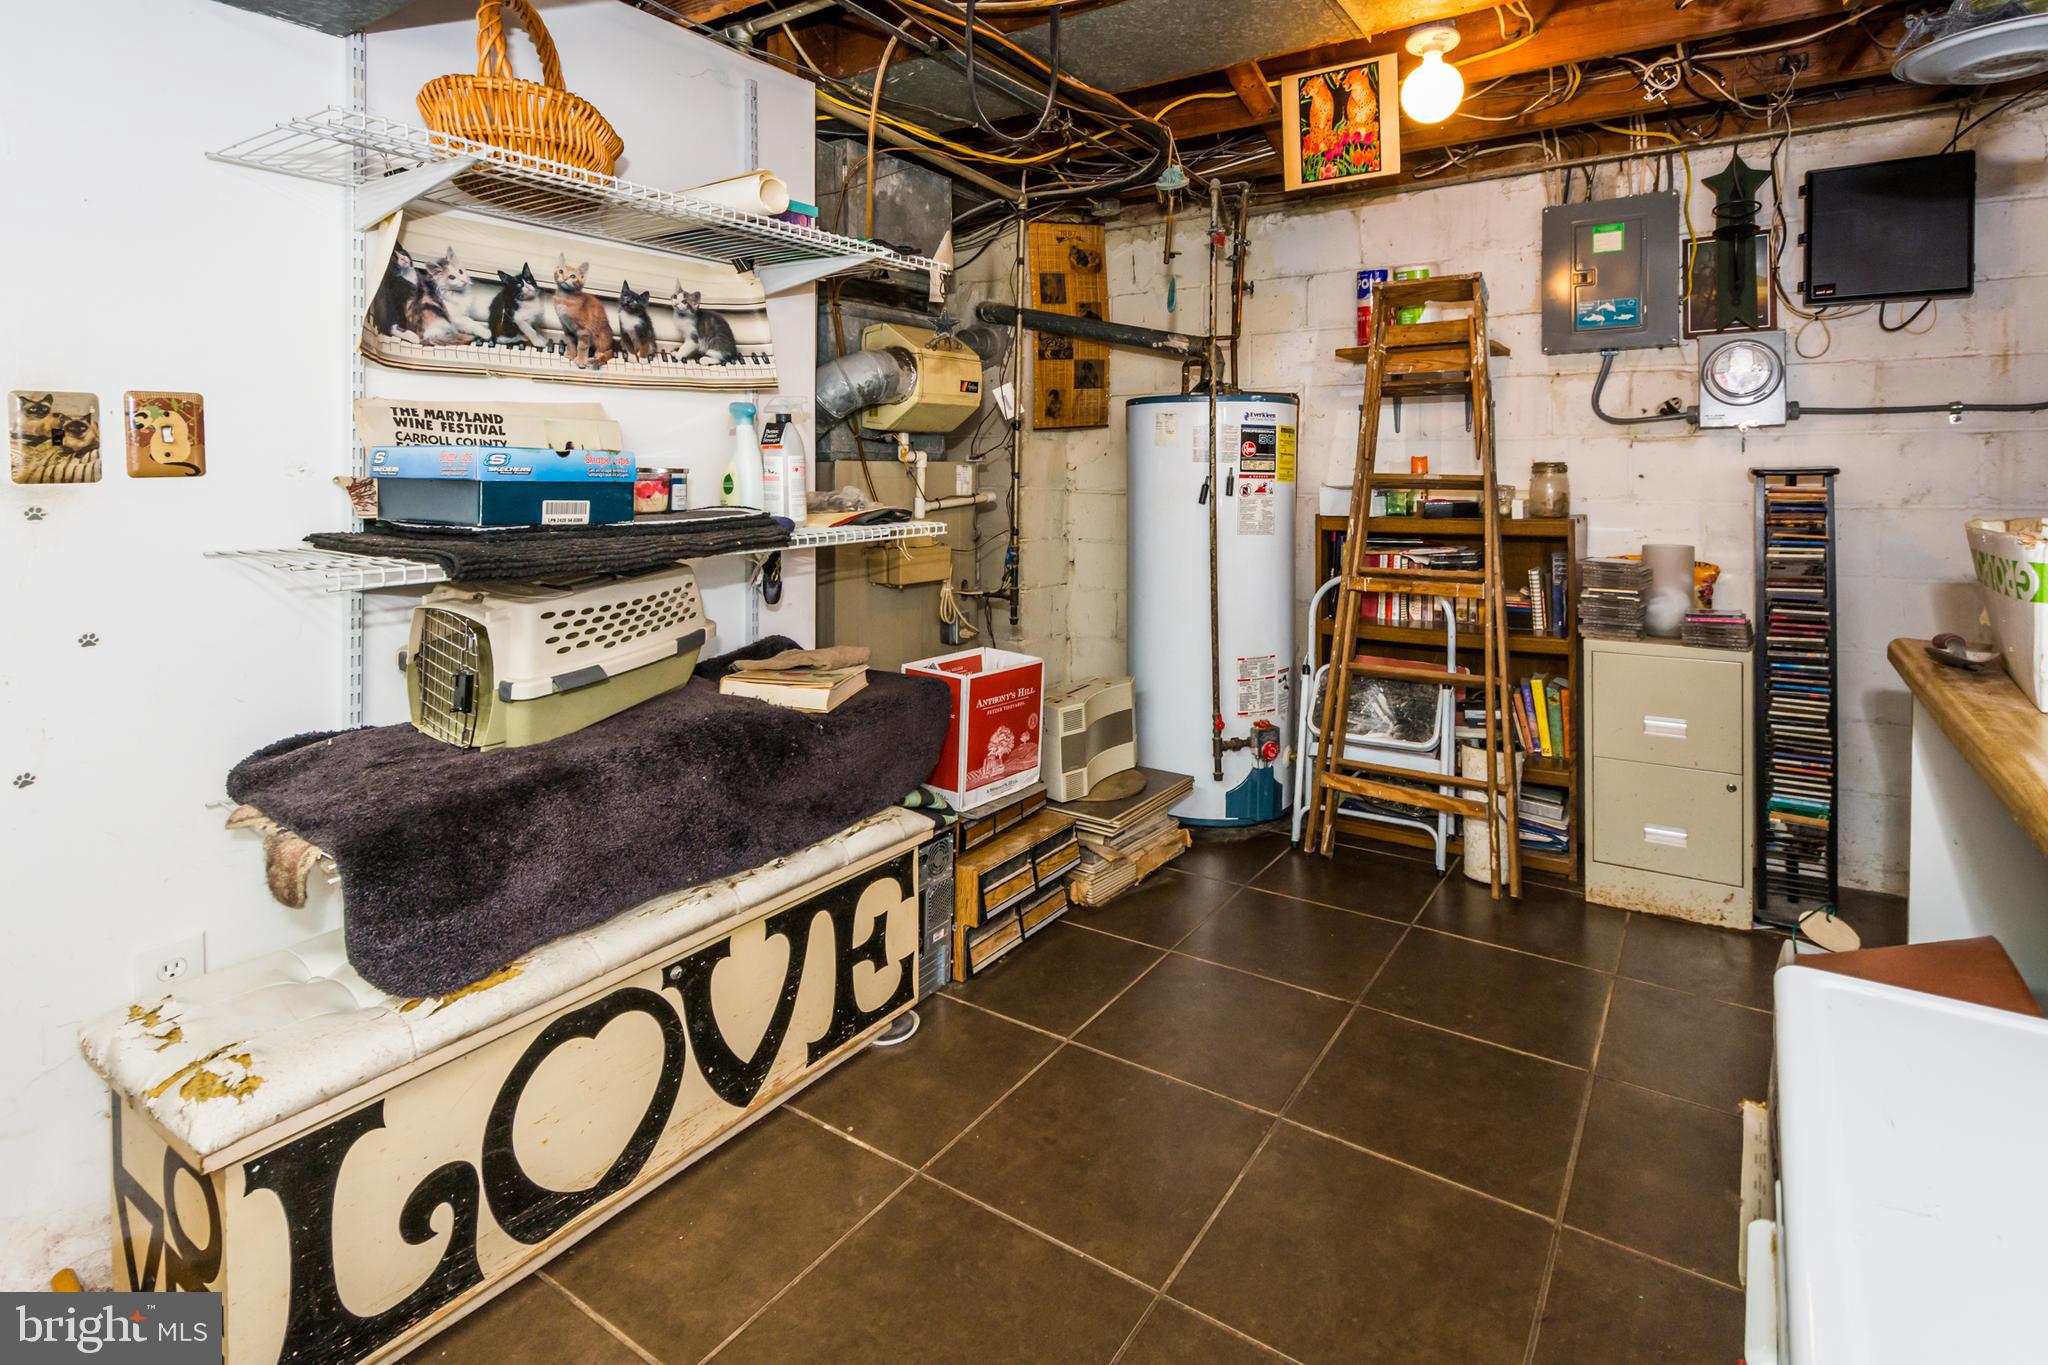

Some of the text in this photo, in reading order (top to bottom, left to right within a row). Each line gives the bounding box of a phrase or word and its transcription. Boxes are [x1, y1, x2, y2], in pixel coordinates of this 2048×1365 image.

[390, 406, 504, 424] THE MARYLAND
[393, 417, 506, 436] WINE FESTIVAL
[395, 431, 508, 447] CARROLL COUNTY
[1017, 687, 1036, 698] HILL
[243, 853, 917, 1365] LOVE
